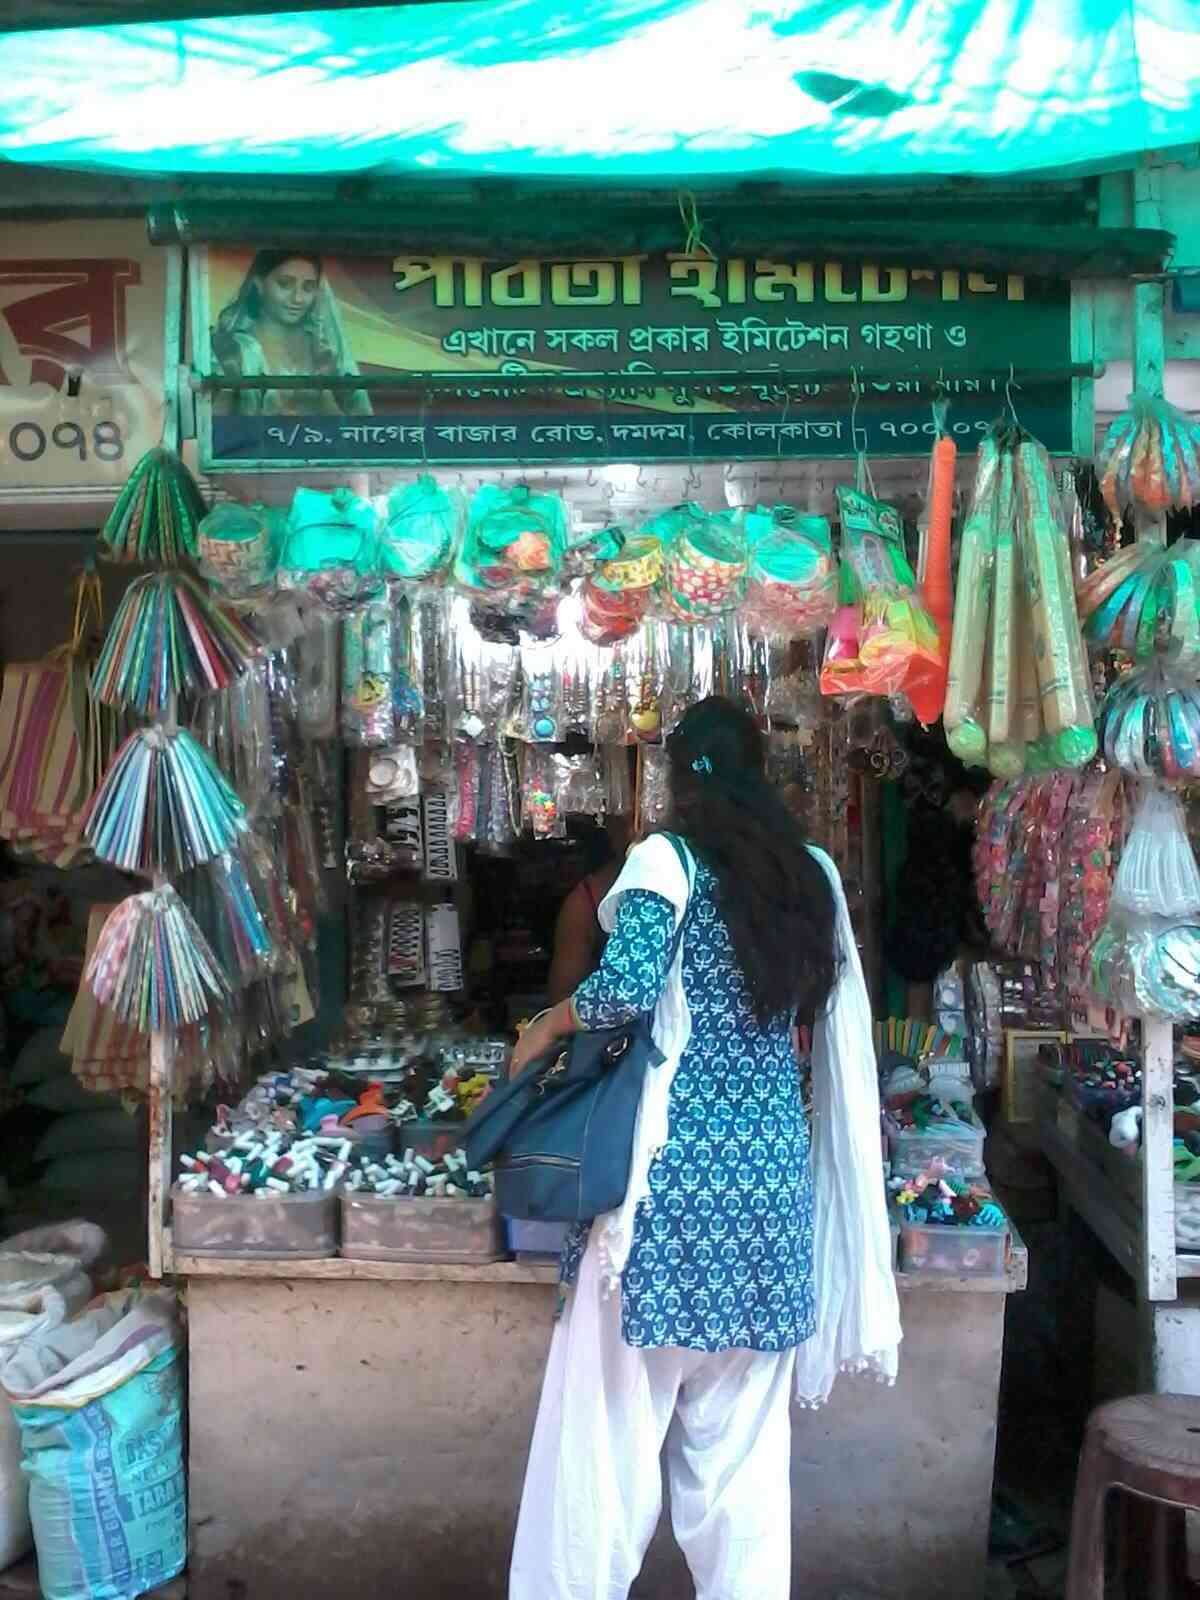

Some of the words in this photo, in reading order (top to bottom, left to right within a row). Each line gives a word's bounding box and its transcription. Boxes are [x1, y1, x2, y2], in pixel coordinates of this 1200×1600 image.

[442, 326, 536, 356] এখানে
[544, 328, 619, 353] সকল
[628, 325, 710, 353] প্রকার
[716, 316, 849, 353] ইমিটেশন
[944, 325, 967, 347] ও
[9, 421, 124, 461] ০৭৪
[339, 424, 425, 444] নাগের
[434, 423, 517, 443] বাজার
[707, 420, 842, 443] কোলকাতা
